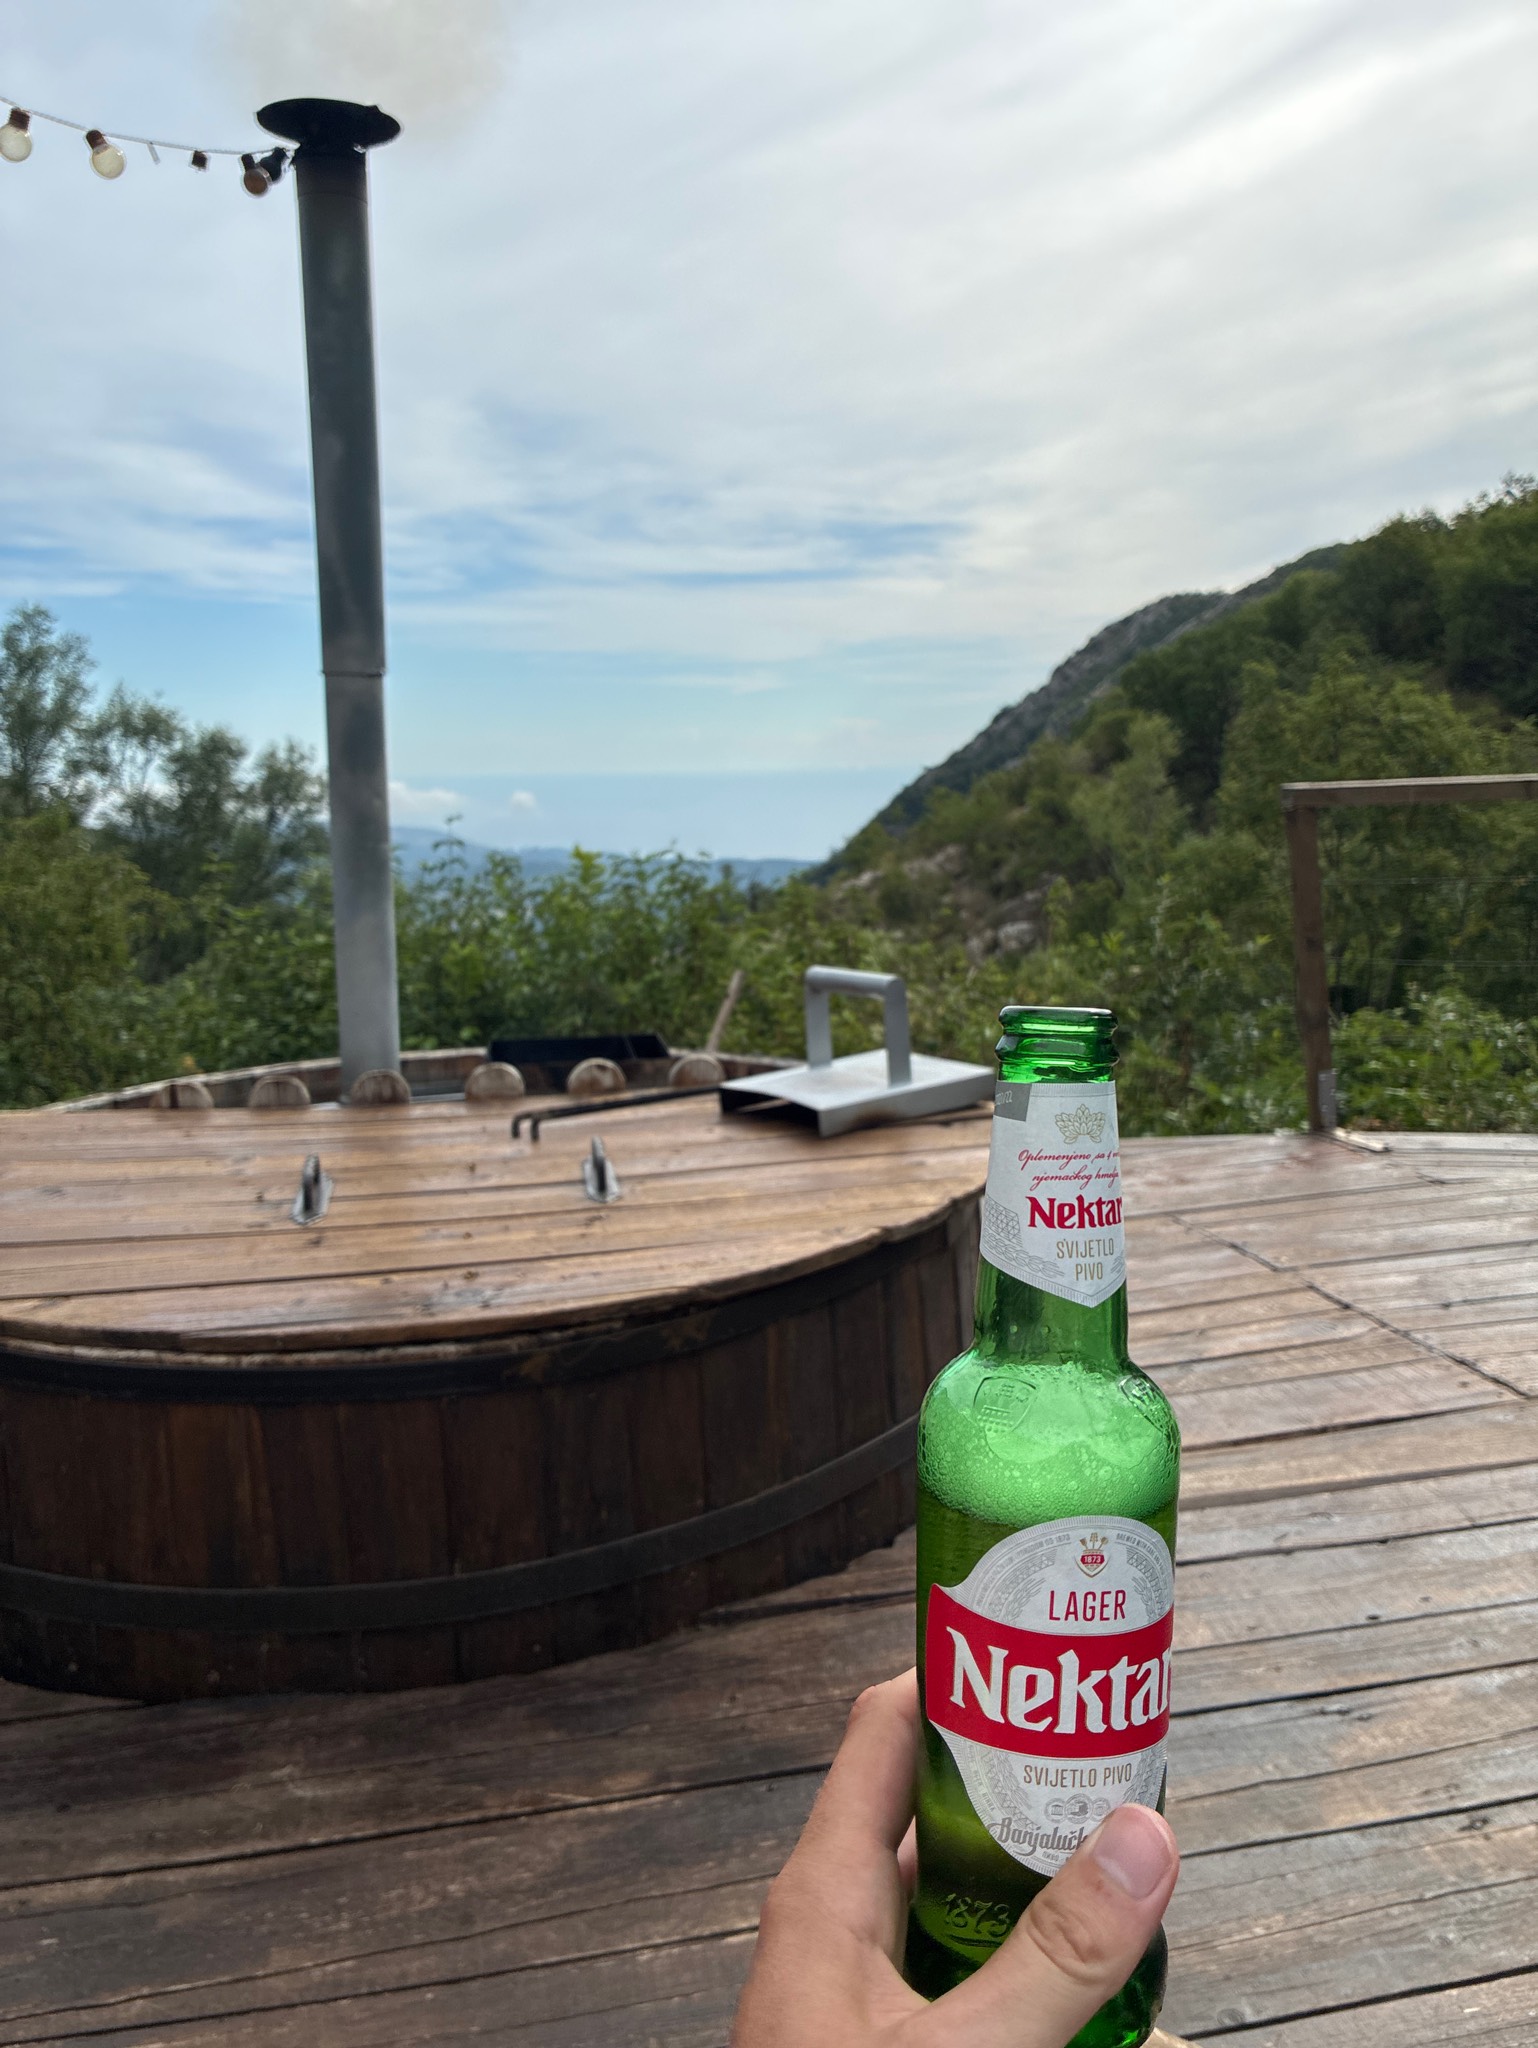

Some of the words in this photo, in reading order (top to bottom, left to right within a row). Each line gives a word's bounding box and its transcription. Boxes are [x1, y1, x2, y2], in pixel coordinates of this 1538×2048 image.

[1018, 1149, 1091, 1171] Oplemenjeno
[1029, 1164, 1093, 1191] njemačkog
[1025, 1194, 1122, 1229] Nektar
[1056, 1238, 1115, 1259] SVIJETLO
[1075, 1262, 1103, 1281] PIVO
[1083, 1556, 1101, 1564] 1873
[1049, 1589, 1127, 1622] LAGER
[1023, 1765, 1097, 1788] SVIJETLO
[1103, 1763, 1132, 1786] PIVO
[987, 1816, 1088, 1857] Banjalučk
[942, 1892, 1011, 1938] 1873
